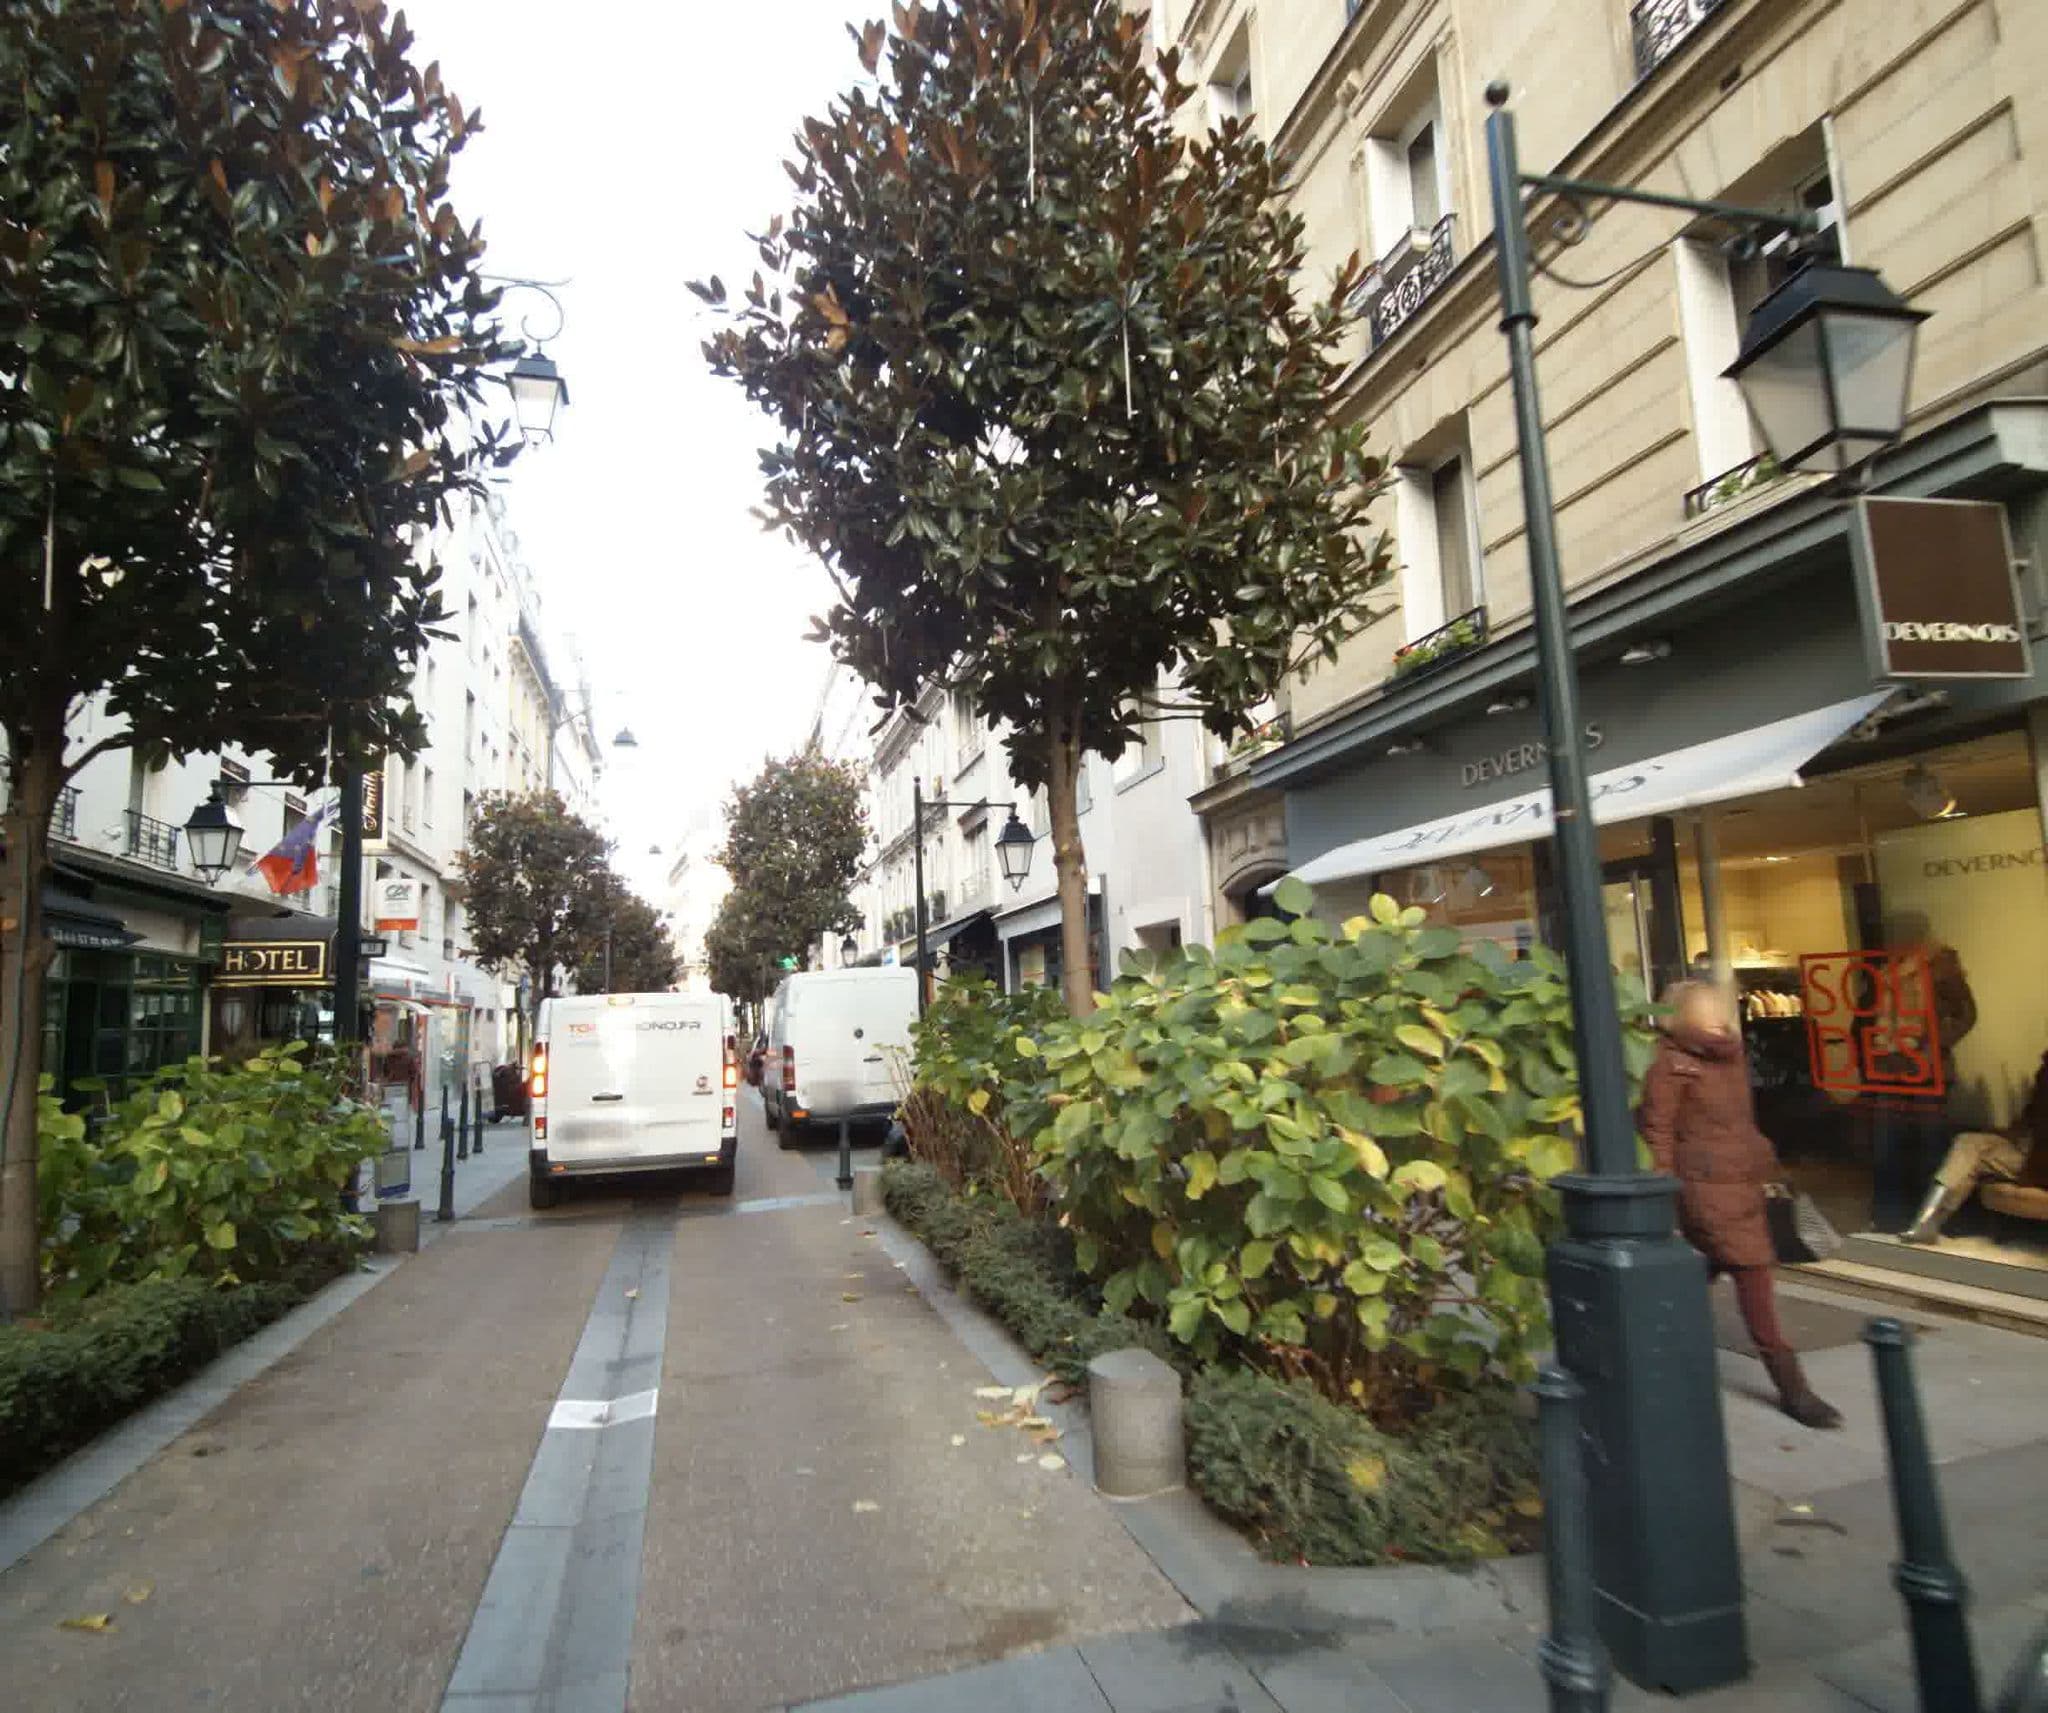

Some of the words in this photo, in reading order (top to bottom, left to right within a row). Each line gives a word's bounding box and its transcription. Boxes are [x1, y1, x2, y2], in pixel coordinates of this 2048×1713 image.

[1880, 621, 2022, 643] DEVERNOIS
[1461, 722, 1603, 787] DEVERNS
[225, 950, 309, 972] HOTEL
[1815, 1024, 1930, 1083] DES
